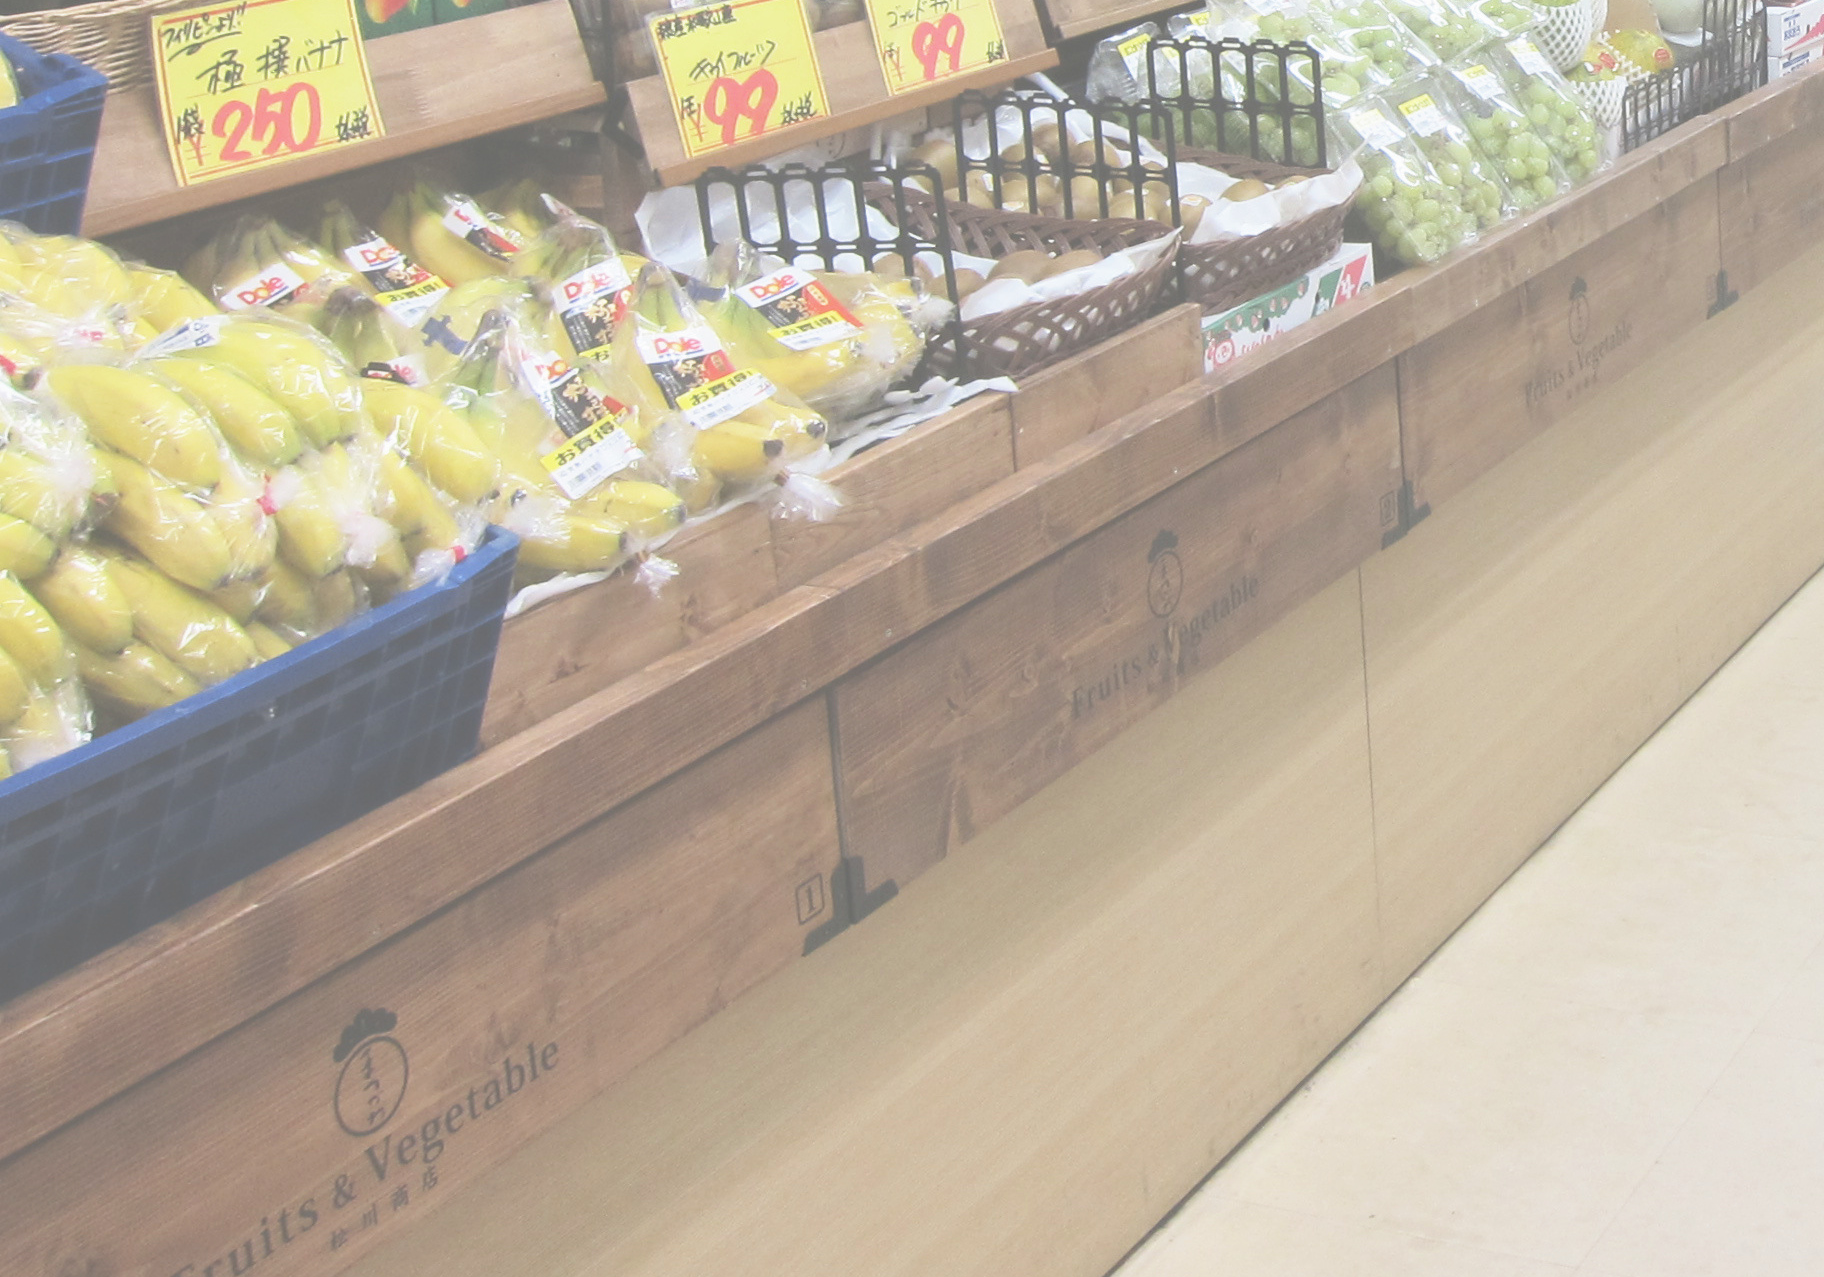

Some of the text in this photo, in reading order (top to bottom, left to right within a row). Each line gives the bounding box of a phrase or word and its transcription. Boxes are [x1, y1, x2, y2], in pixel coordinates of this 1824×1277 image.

[912, 12, 965, 82] 99
[212, 82, 322, 162] 250
[704, 68, 779, 145] 99
[236, 275, 287, 305] Dole
[564, 271, 612, 299] Dole
[748, 273, 797, 299] Dole
[654, 336, 704, 355] Dole
[331, 1173, 357, 1211] &
[365, 1036, 561, 1181] Vegetable
